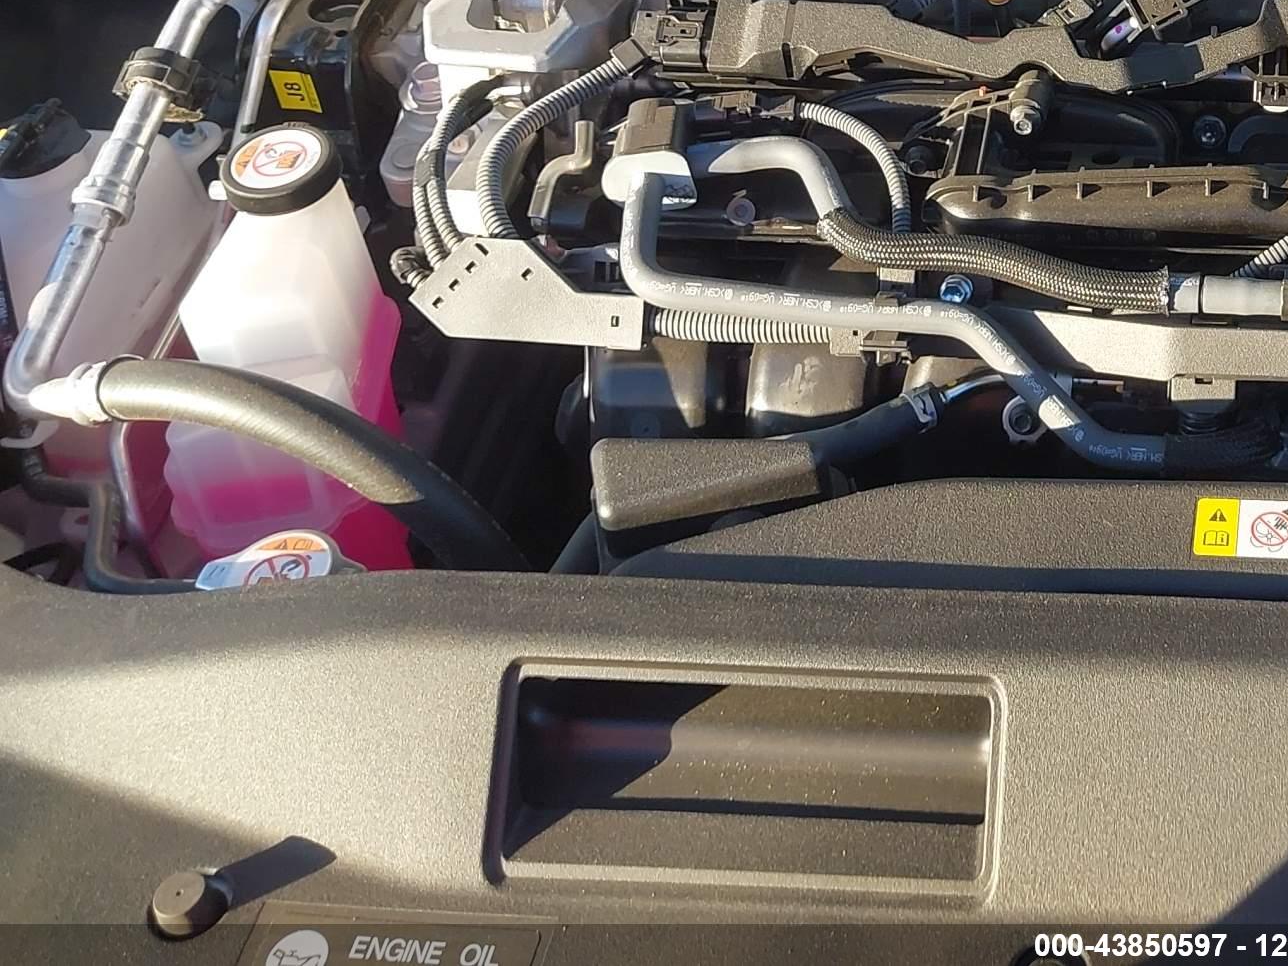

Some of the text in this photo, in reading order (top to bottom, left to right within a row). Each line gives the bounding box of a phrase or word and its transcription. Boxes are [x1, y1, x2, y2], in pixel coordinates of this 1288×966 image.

[284, 82, 305, 102] J8
[348, 936, 500, 966] ENGINE OIL
